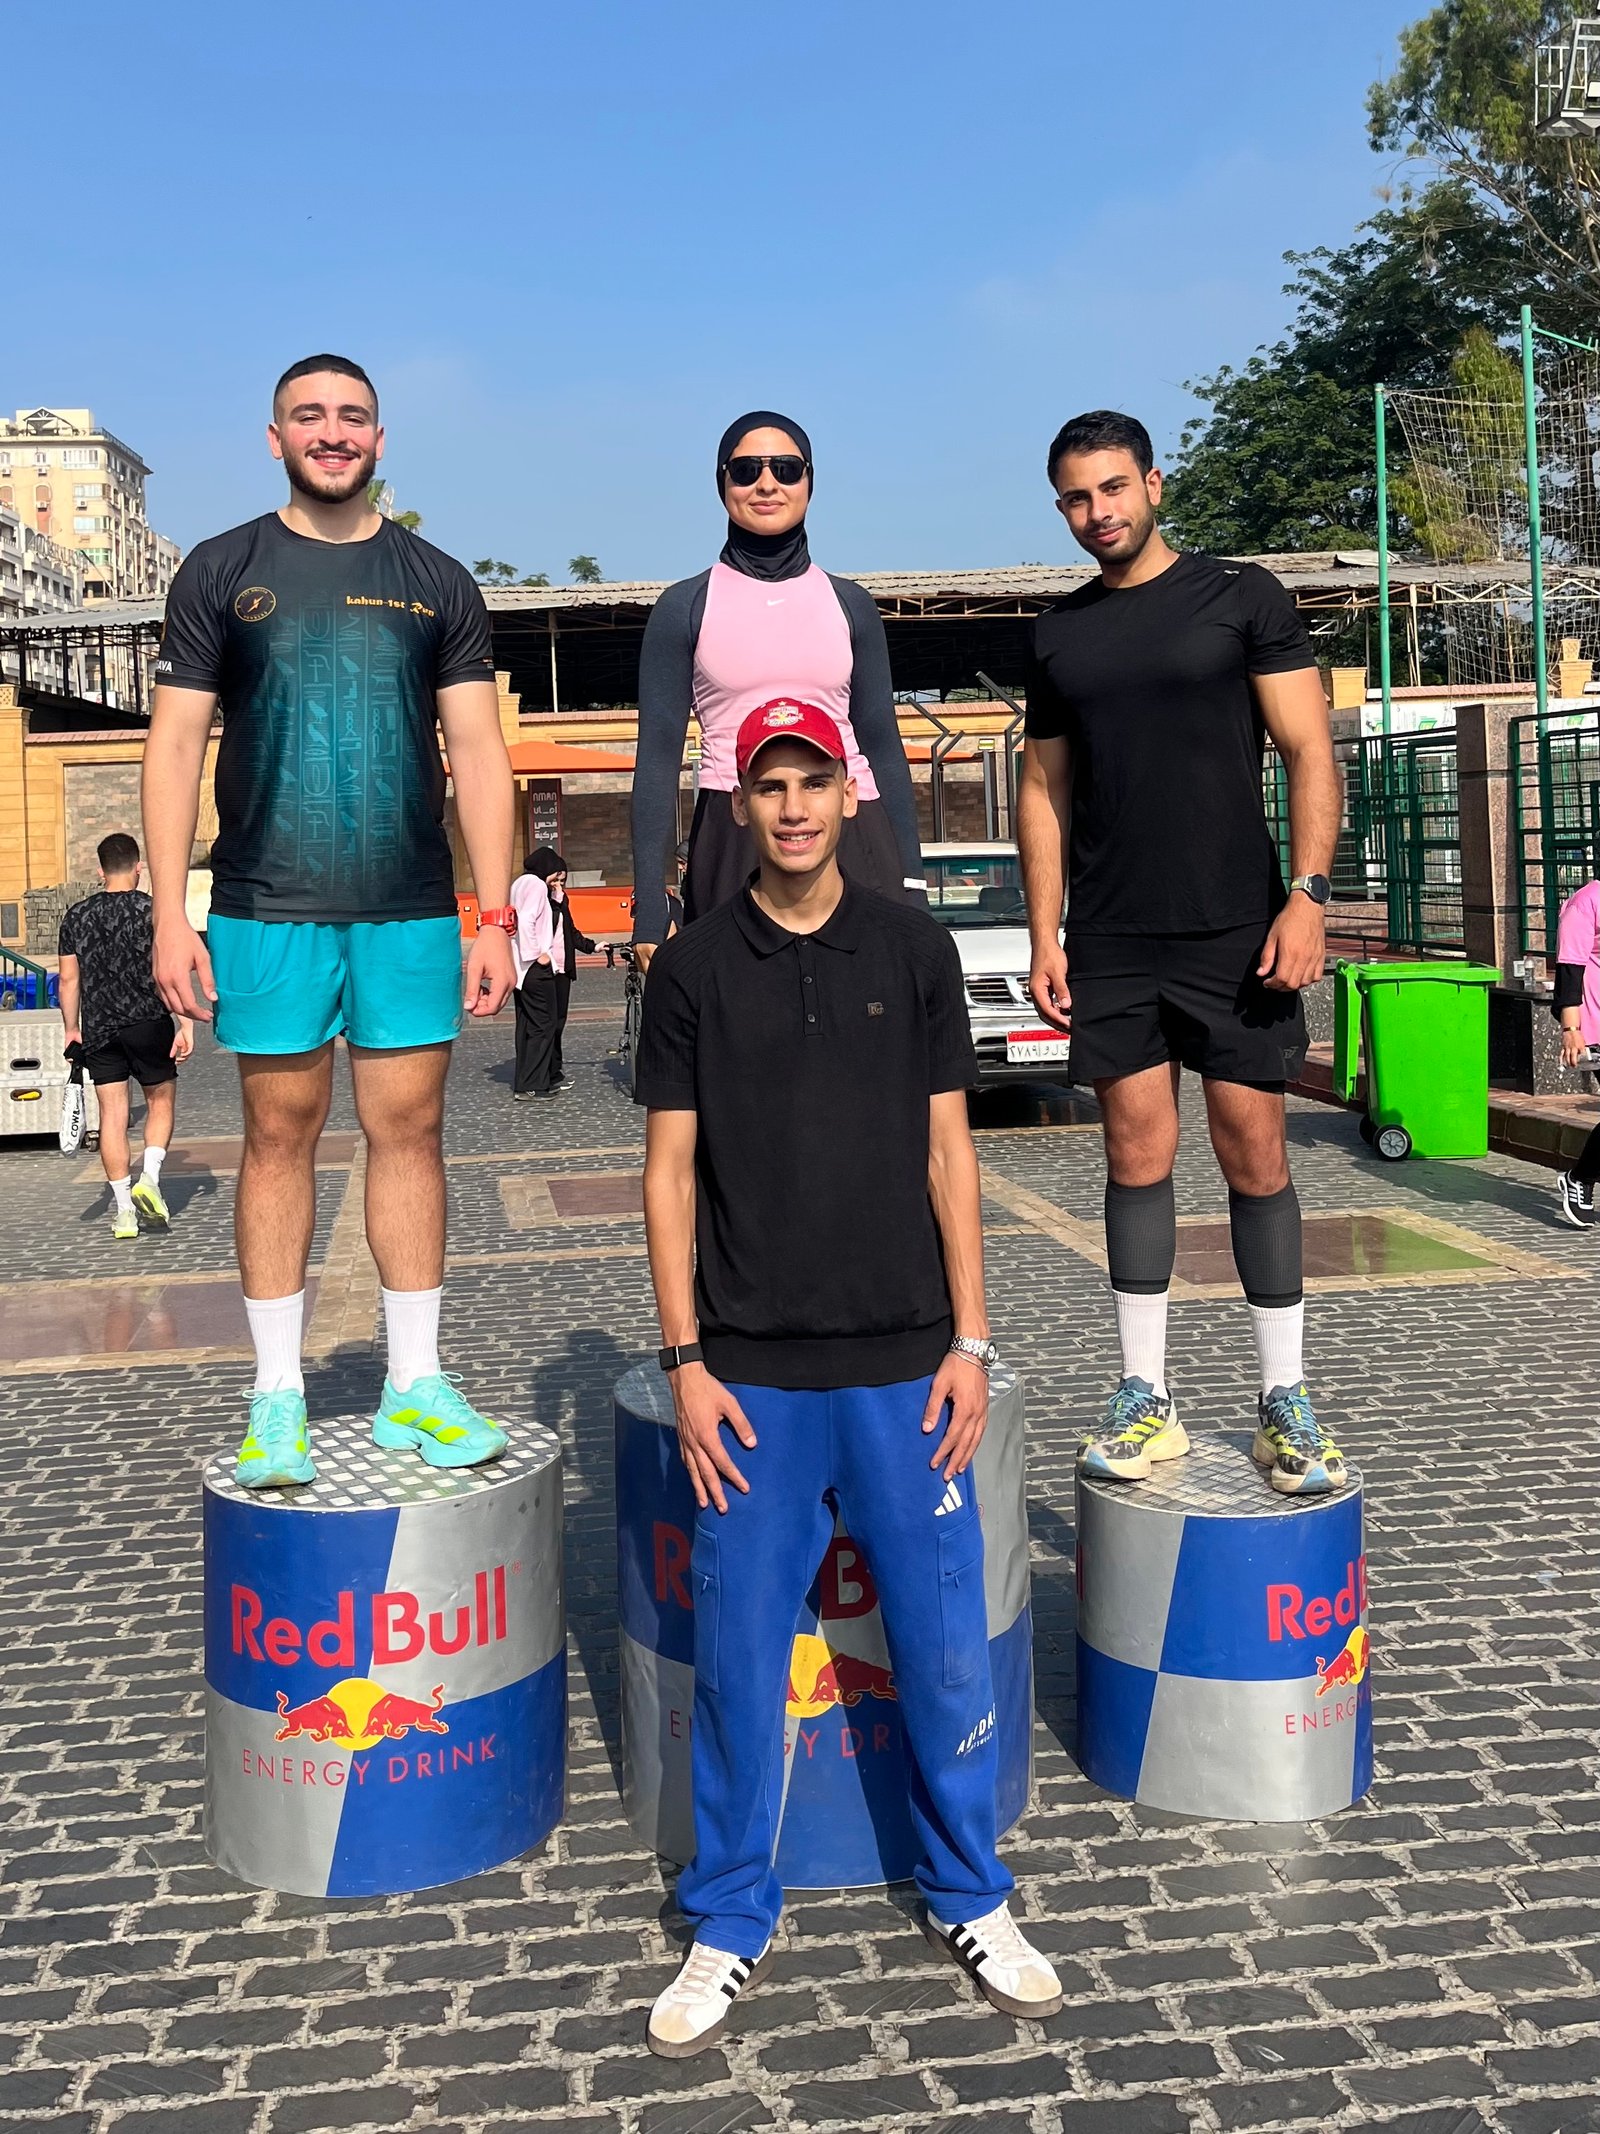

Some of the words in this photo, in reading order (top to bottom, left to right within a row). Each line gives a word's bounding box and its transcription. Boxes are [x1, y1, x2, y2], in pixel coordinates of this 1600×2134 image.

[410, 602, 434, 617] Run
[534, 818, 558, 830] فحص
[534, 830, 559, 841] مركبة
[231, 1583, 355, 1668] Red
[371, 1565, 507, 1666] Bull
[1266, 1561, 1357, 1642] Red
[243, 1748, 371, 1786] ENERGY
[388, 1733, 497, 1783] DRINK
